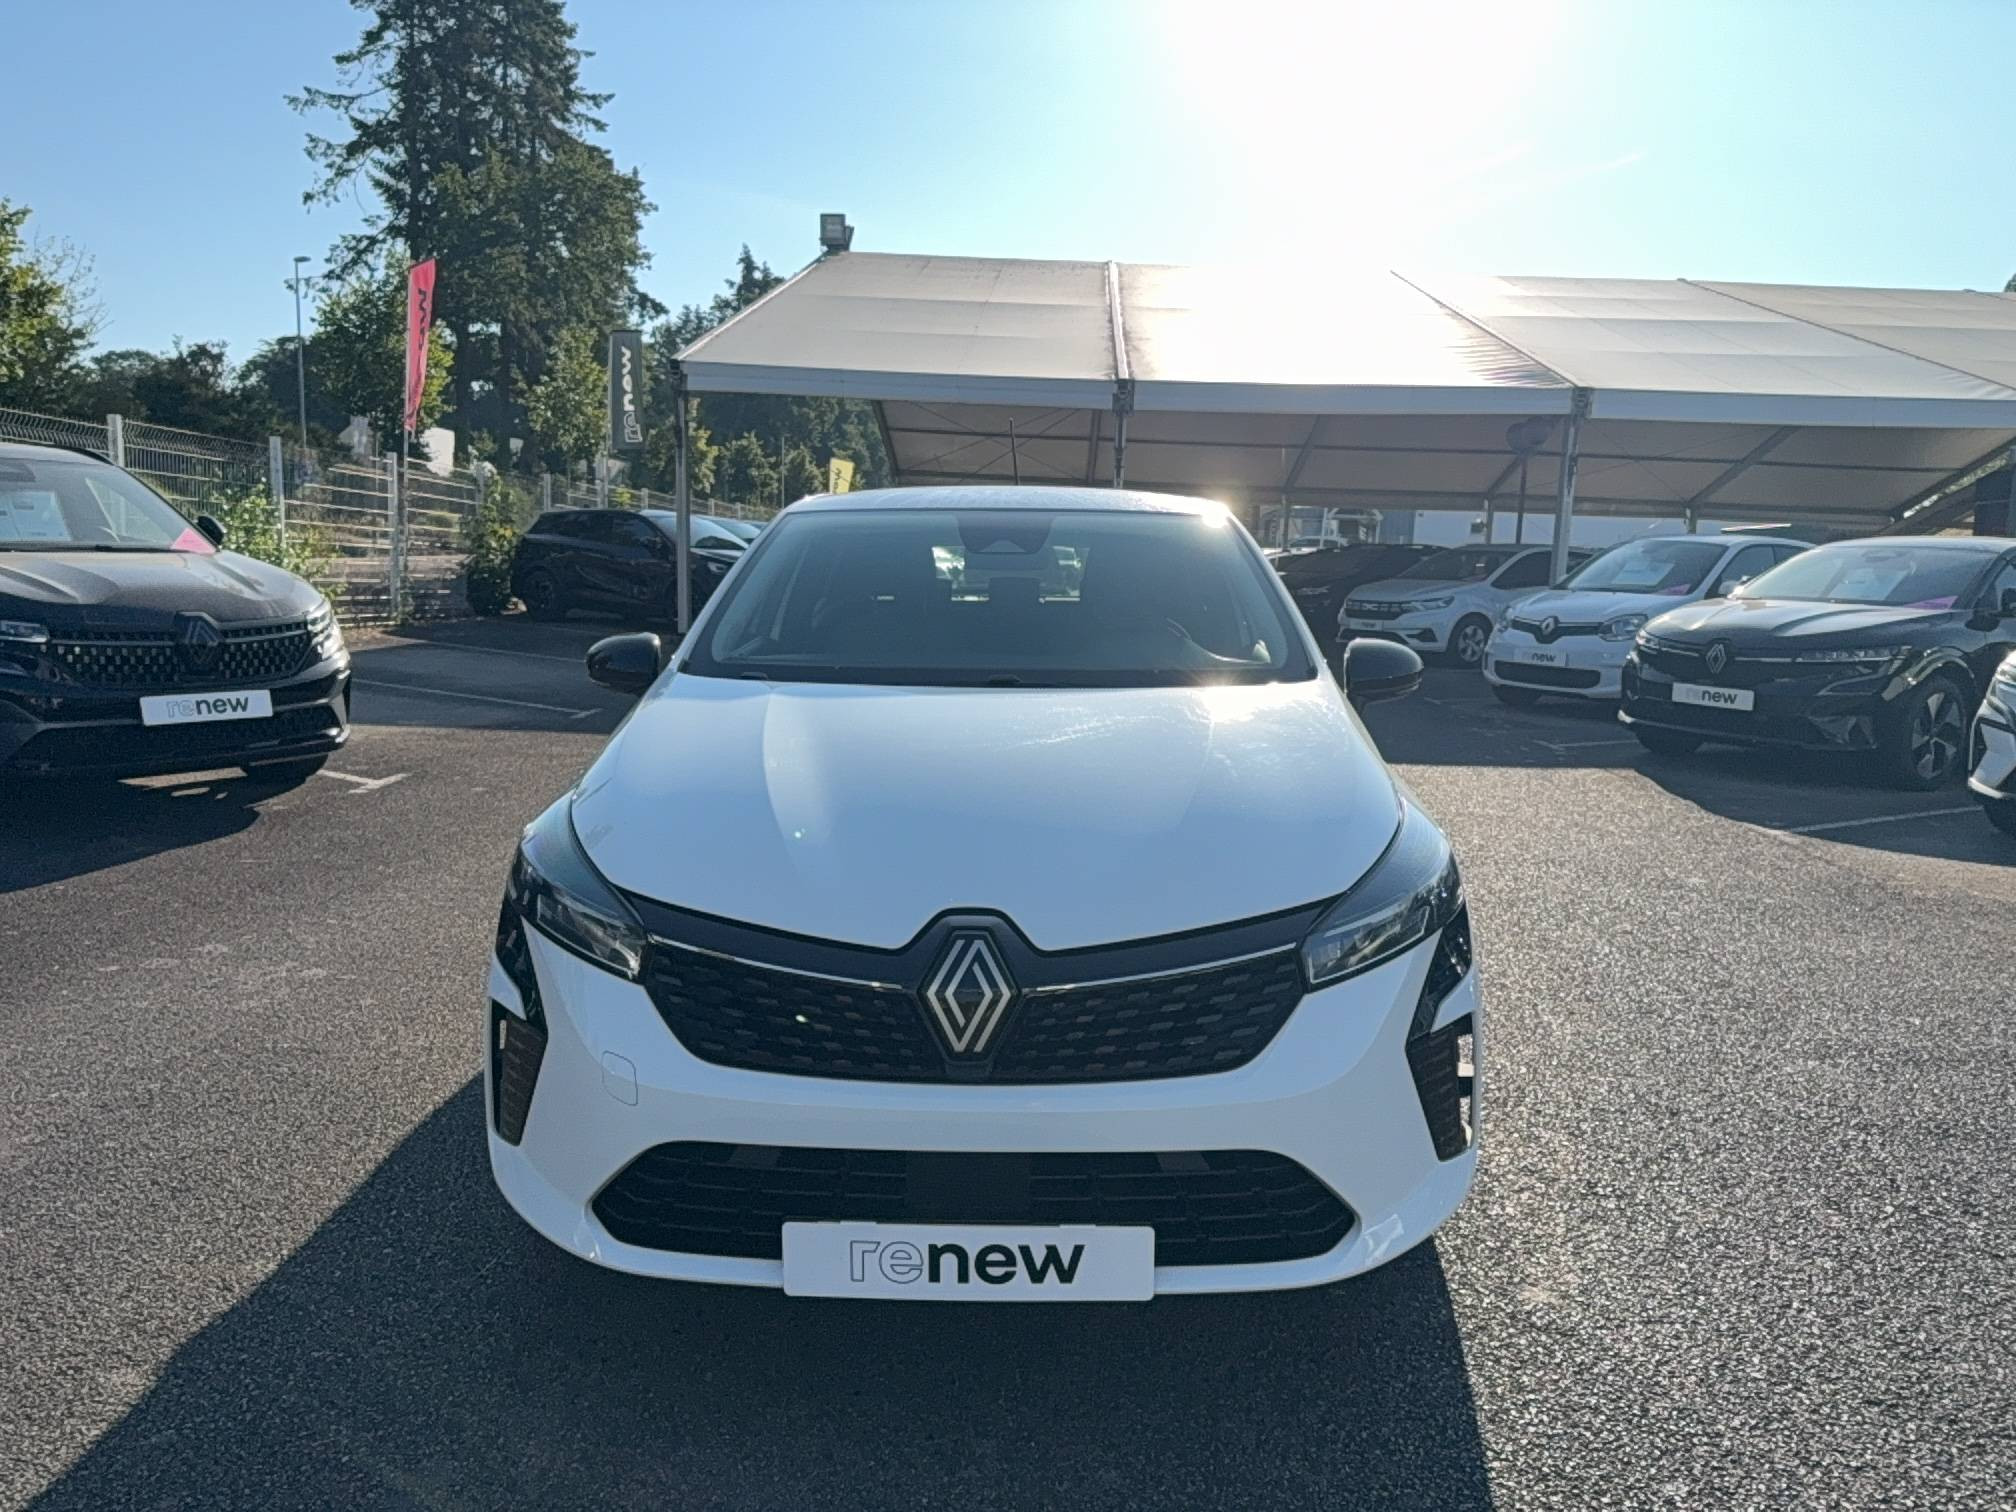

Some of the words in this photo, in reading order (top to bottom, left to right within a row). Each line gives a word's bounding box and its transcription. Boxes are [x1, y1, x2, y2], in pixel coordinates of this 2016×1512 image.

[621, 346, 643, 443] renew
[166, 697, 249, 718] renew
[850, 1240, 1086, 1285] renew
